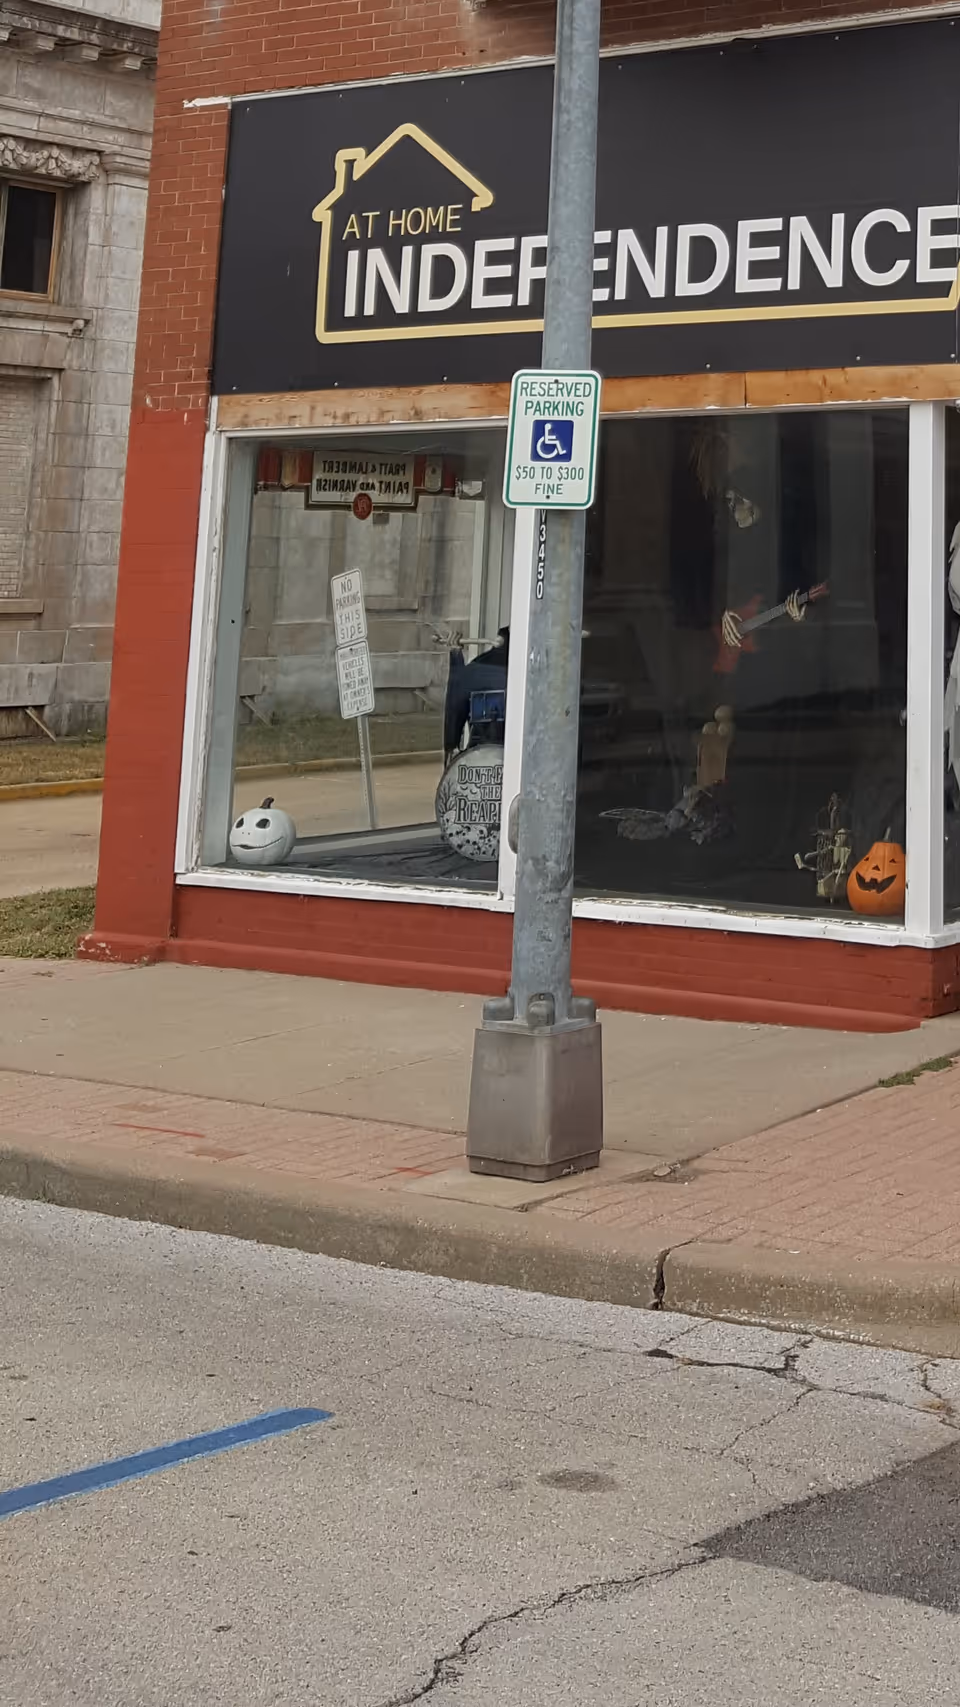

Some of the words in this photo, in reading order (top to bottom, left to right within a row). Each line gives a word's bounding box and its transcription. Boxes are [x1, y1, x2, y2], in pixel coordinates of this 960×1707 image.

[342, 211, 380, 240] AT
[388, 204, 463, 236] HOME
[519, 381, 592, 397] RESERVED
[524, 400, 585, 416] PARKING
[515, 465, 535, 481] $50
[540, 466, 552, 480] TO
[557, 466, 584, 481] $300
[534, 483, 563, 495] FINE
[340, 578, 353, 594] NO
[335, 591, 361, 610] PARKING
[339, 609, 361, 625] THIS
[340, 622, 363, 640] SIDE
[481, 785, 501, 800] THE
[456, 796, 501, 823] REAP
